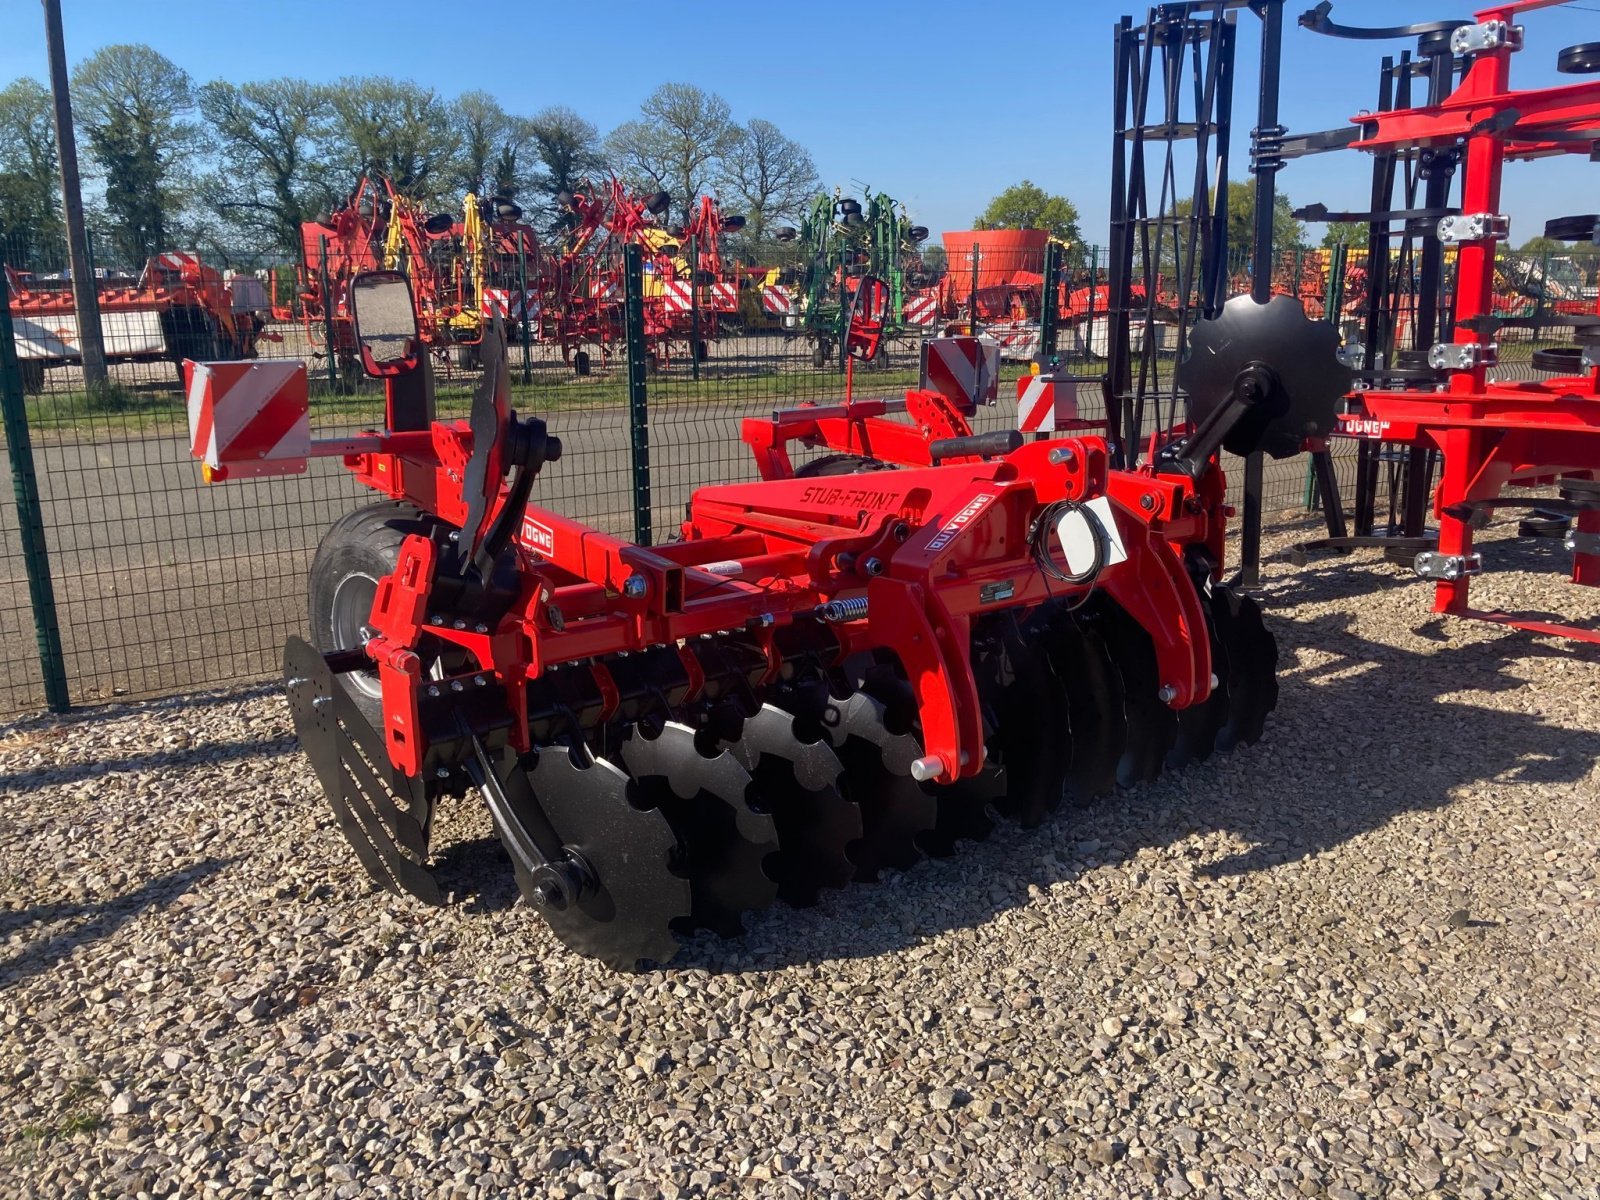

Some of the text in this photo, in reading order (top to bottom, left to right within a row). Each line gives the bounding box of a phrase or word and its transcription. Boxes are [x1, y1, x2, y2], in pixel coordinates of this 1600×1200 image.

[1333, 419, 1380, 434] VOGNE
[800, 486, 899, 511] STUB-FRONT
[929, 495, 989, 549] QUIVOGNE
